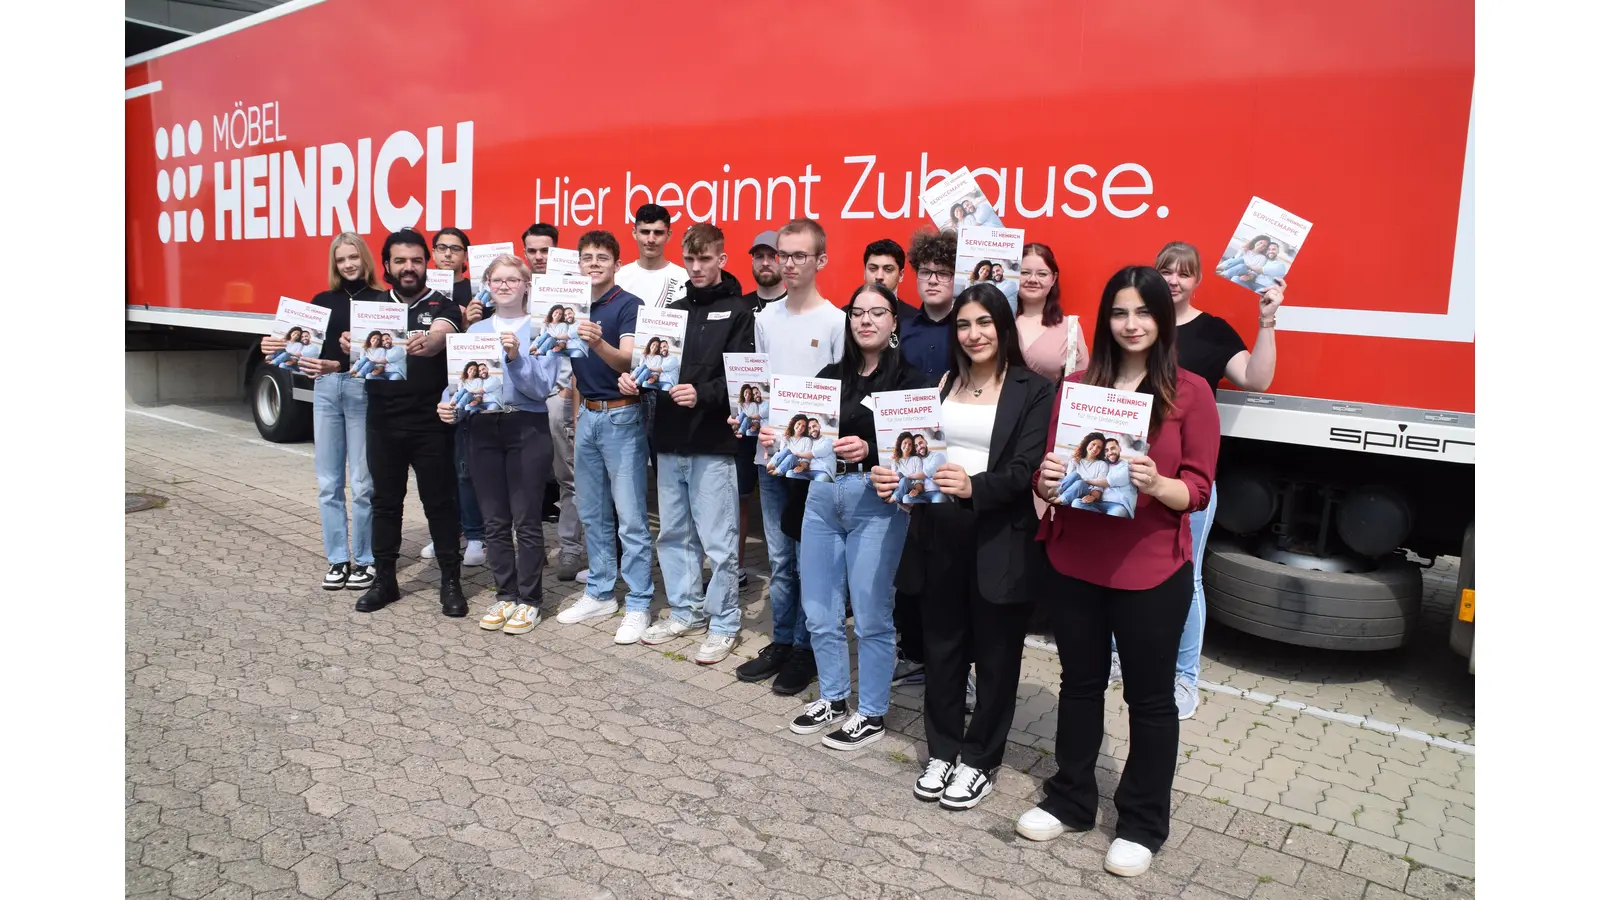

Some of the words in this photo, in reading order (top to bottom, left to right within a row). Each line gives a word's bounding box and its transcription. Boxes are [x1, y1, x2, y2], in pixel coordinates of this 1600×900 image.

[213, 101, 287, 152] MÖBEL
[214, 120, 474, 241] HEINRICH
[535, 176, 611, 227] Hier
[625, 164, 821, 229] beginnt
[840, 152, 1170, 219] Zuhause.
[930, 180, 968, 206] SERVICEMAPPE
[1253, 210, 1299, 237] SERVICEMAPPE
[965, 239, 1015, 249] SERVICEMAPPE
[284, 308, 322, 322] SERVICEMAPPE
[357, 312, 400, 320] SERVICEMAPPE
[642, 318, 679, 328] SERVICEMAPPE
[778, 390, 832, 402] SERVICEMAPPE
[1116, 398, 1148, 408] HEINRICH
[880, 406, 933, 416] SERVICEMAPPE
[1070, 402, 1139, 420] SERVICEMAPPE
[1329, 424, 1475, 453] spier
